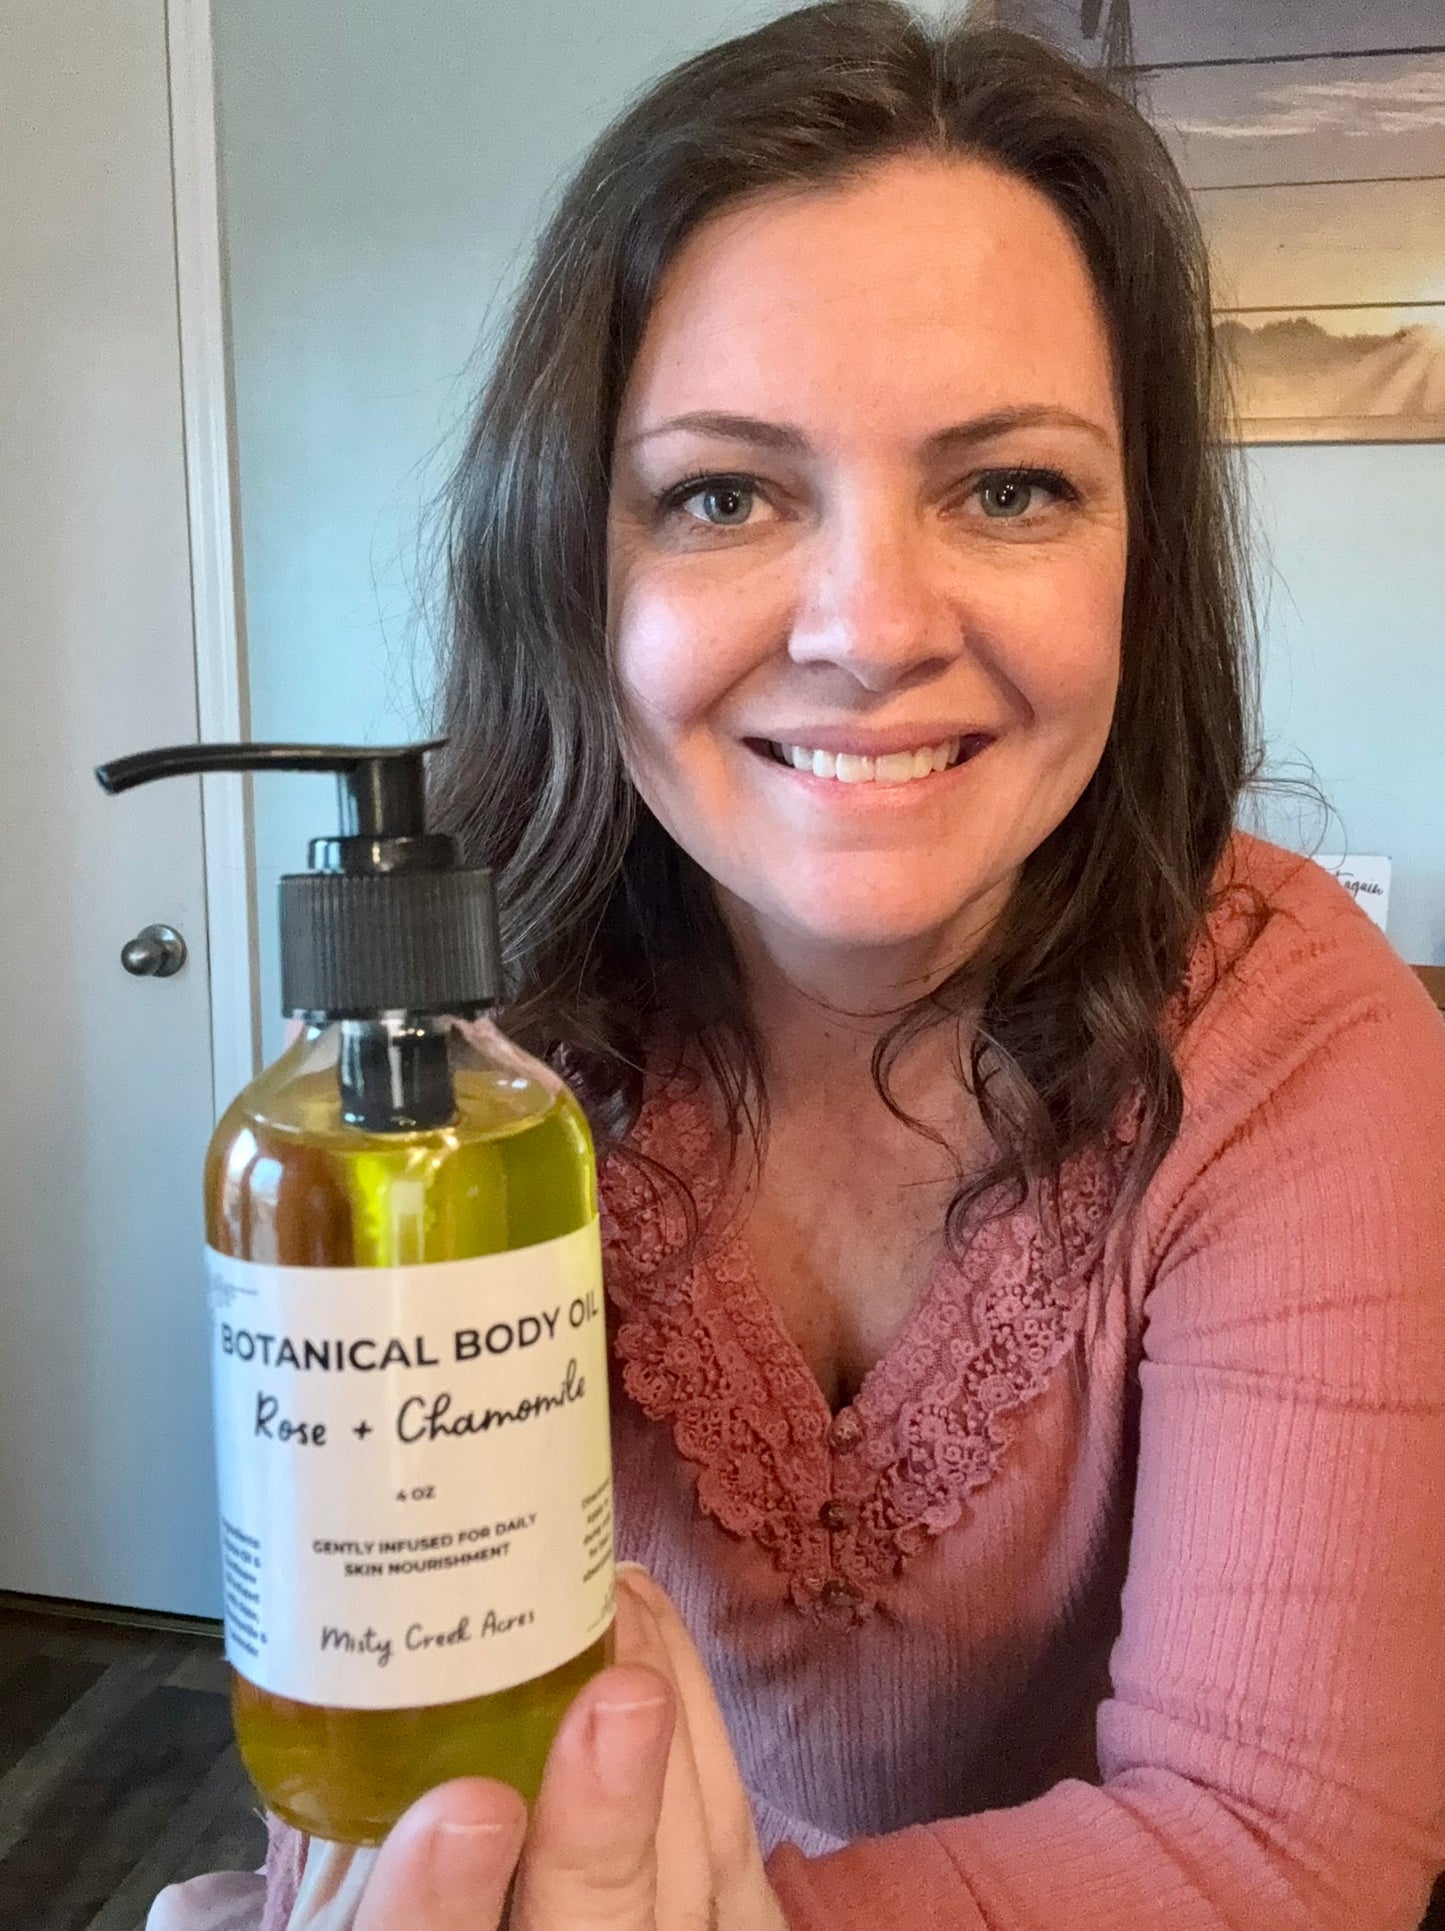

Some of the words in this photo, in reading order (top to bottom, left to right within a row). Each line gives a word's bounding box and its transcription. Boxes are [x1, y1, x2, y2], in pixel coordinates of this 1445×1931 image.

[221, 1322, 439, 1372] BOTANICAL
[454, 1306, 561, 1363] BODY
[569, 1291, 599, 1329] OIL
[254, 1389, 327, 1446] Rose
[396, 1357, 586, 1445] Chamomile
[411, 1484, 436, 1502] OZ
[311, 1540, 373, 1555] GENTLY
[378, 1532, 454, 1555] INFUSED
[458, 1525, 491, 1545] FOR
[495, 1512, 538, 1536] DAILY
[344, 1561, 383, 1577] SKIN
[388, 1541, 511, 1576] NOURISHMENT
[320, 1624, 394, 1668] Misty
[404, 1614, 472, 1652] Creek
[480, 1608, 536, 1639] Acres
